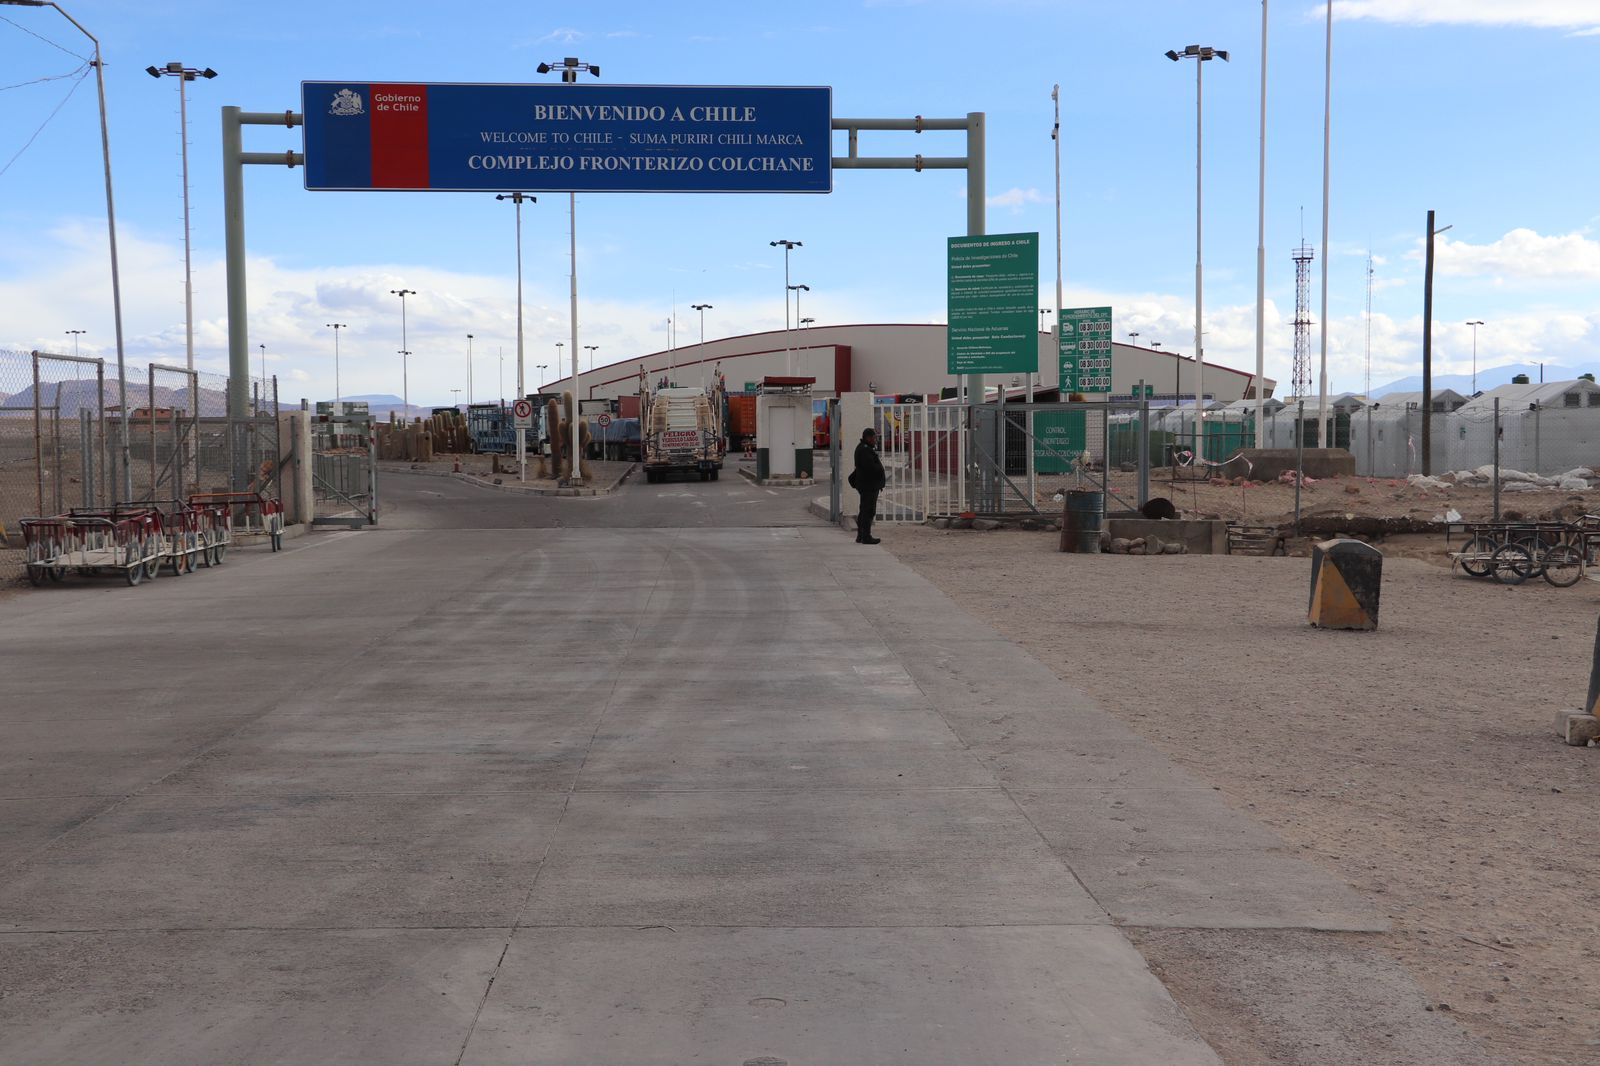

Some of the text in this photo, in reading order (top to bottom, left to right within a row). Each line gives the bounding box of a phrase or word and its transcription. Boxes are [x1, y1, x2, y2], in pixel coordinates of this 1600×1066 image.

[374, 93, 421, 103] Gobierno
[376, 103, 420, 112] de Chile
[535, 105, 757, 121] BIENVENIDO A CHILE
[480, 132, 547, 144] WELCOME
[551, 132, 570, 144] TO
[573, 133, 613, 144] CHILE
[629, 133, 668, 145] SUMA
[671, 134, 713, 145] PURIRI
[718, 134, 752, 145] CHILI
[756, 134, 804, 145] MARCA
[468, 155, 814, 172] COMPLEJO FRONTERIZO COLCHANE
